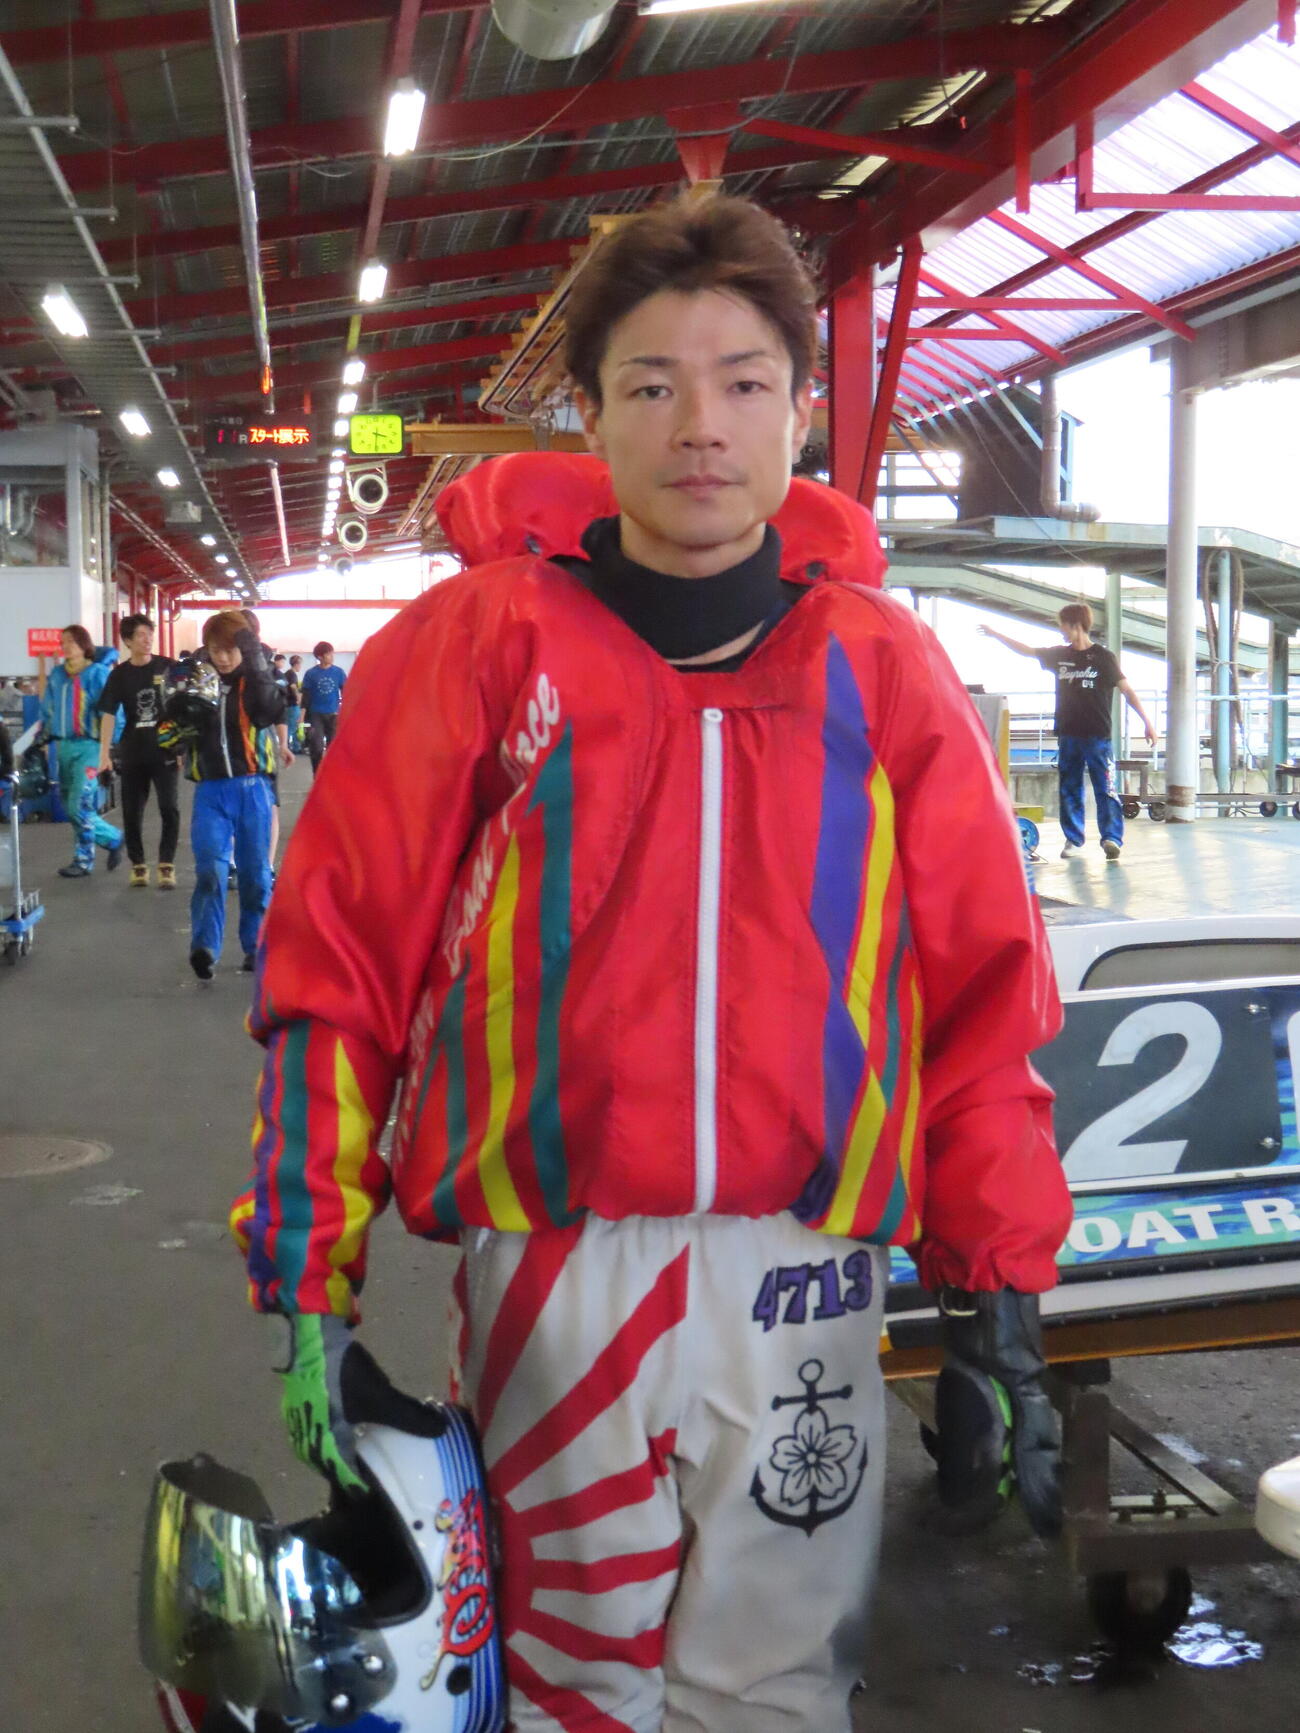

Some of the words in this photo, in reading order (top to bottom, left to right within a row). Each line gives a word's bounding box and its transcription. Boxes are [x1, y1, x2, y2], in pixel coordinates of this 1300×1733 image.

[250, 428, 310, 445] スタート展示
[1062, 1000, 1222, 1182] 2
[1058, 1204, 1222, 1253] OAT
[752, 1249, 873, 1333] 4713
